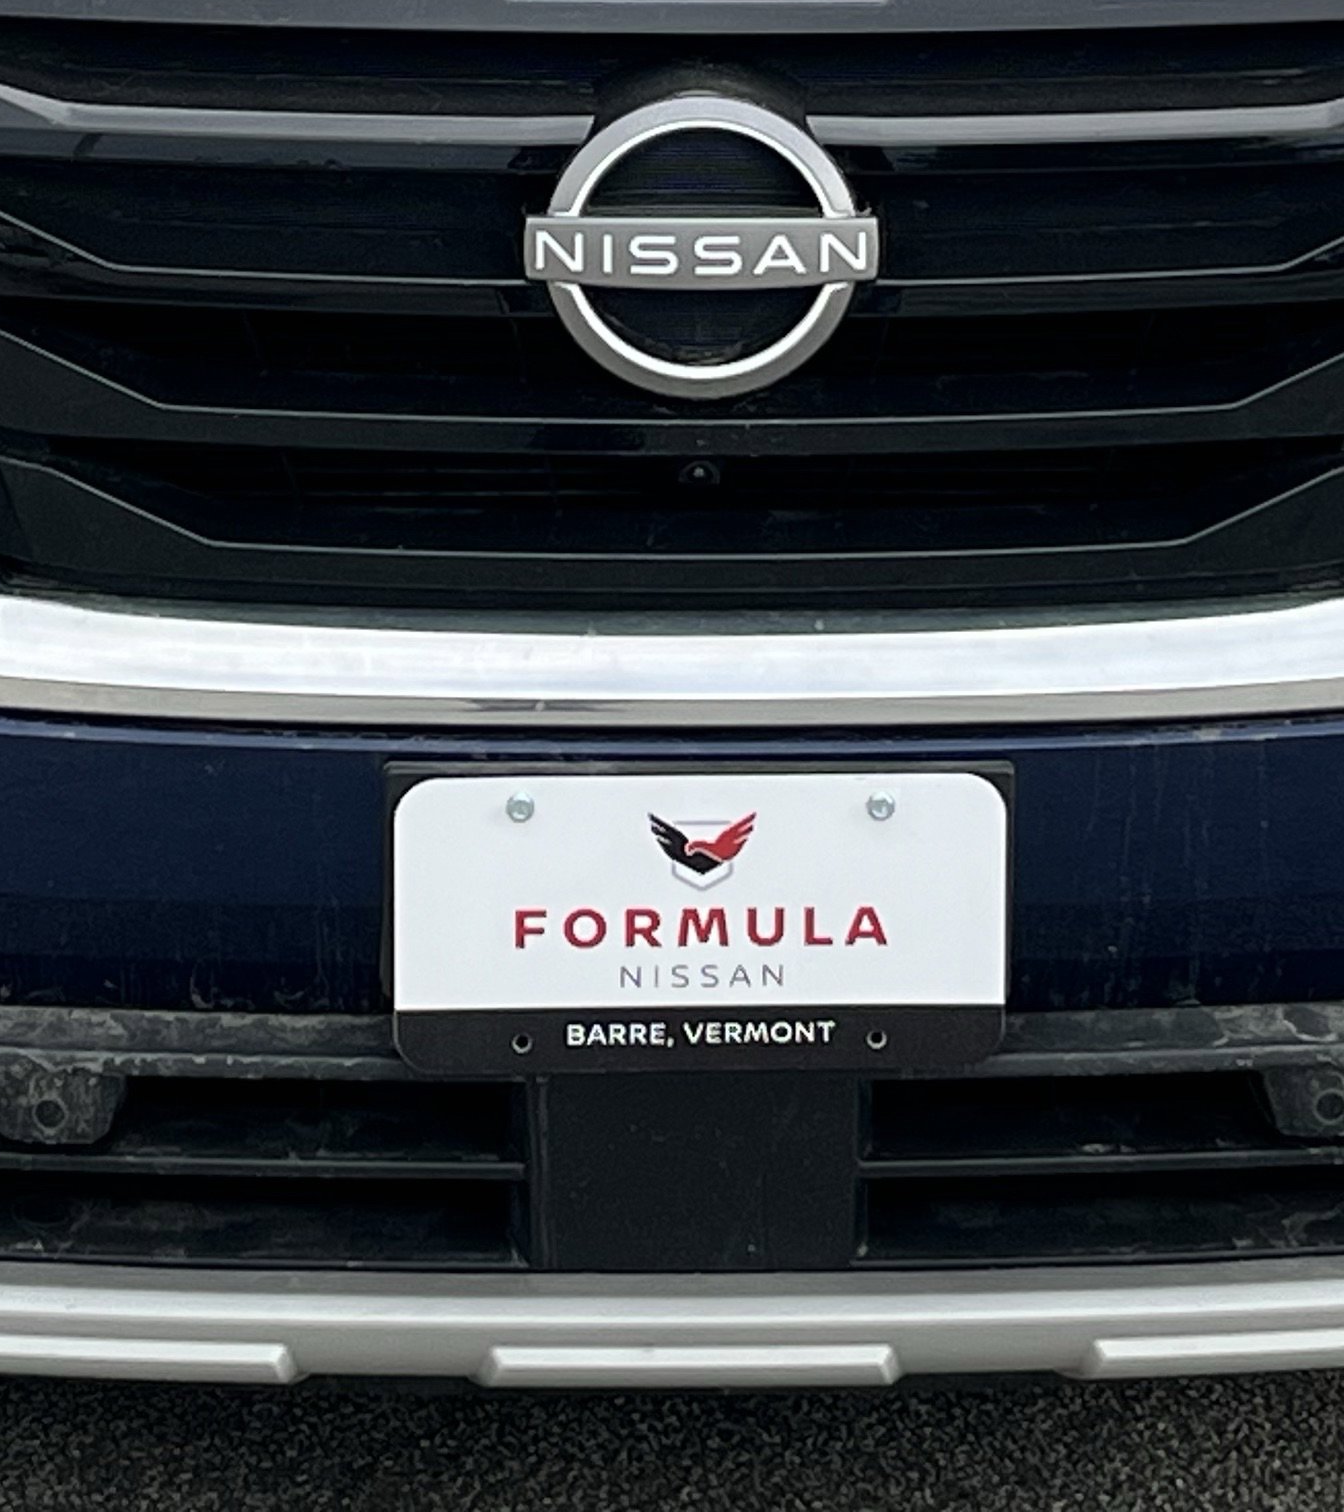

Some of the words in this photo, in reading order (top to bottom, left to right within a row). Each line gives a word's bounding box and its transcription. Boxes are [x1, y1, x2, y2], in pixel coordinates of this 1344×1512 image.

[534, 230, 868, 275] NISSAN
[515, 906, 888, 949] FORMULA
[619, 963, 785, 988] NISSAN
[566, 1022, 675, 1049] BARRE,
[682, 1020, 836, 1044] VERMONT
